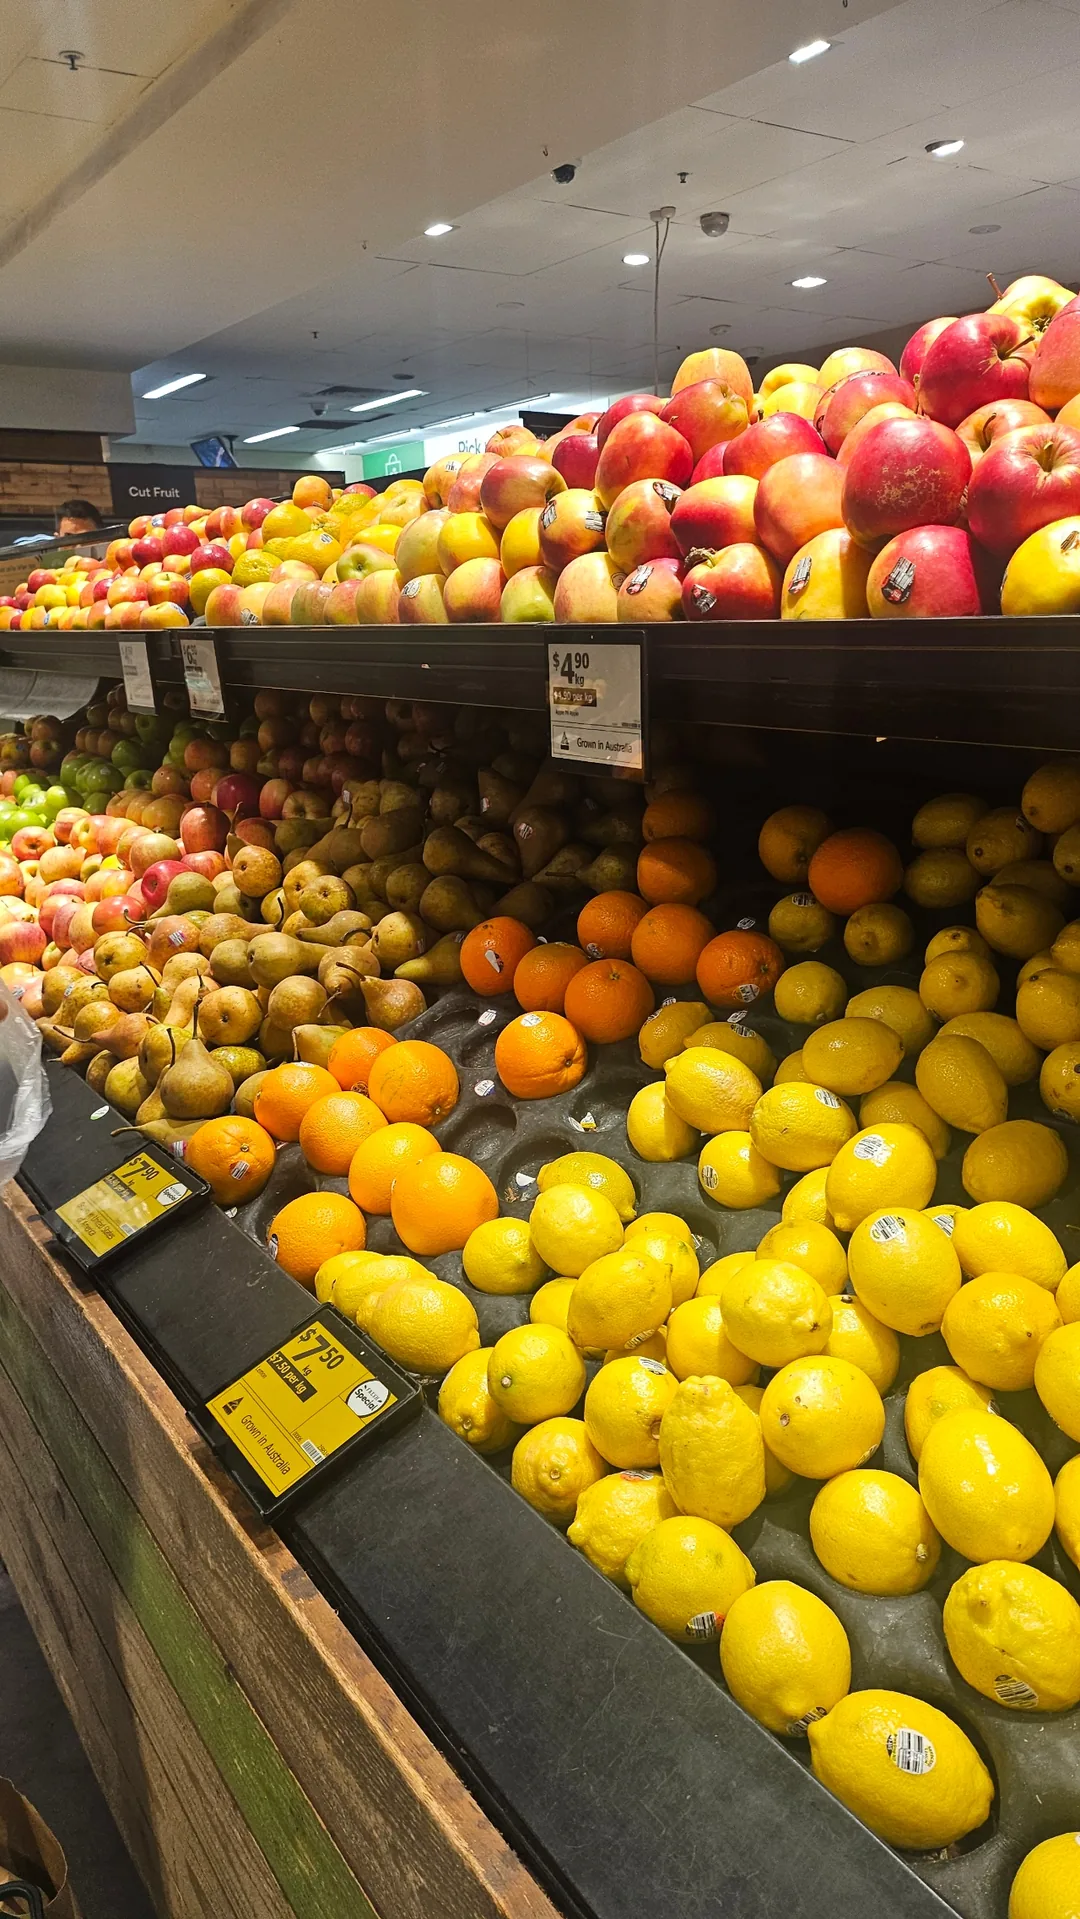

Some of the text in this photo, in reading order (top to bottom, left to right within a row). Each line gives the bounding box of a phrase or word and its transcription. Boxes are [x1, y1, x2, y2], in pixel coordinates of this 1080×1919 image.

[458, 439, 481, 454] Pick
[128, 486, 180, 498] Cut Fruit
[574, 673, 585, 687] kg
[553, 690, 593, 703] $4.90 per kg
[576, 738, 633, 753] Grown in Australia
[102, 1222, 116, 1240] States
[269, 1352, 307, 1394] $7.50 per kg
[301, 1364, 312, 1377] kg
[354, 1388, 379, 1411] Special
[240, 1414, 291, 1476] Grown in Australia
